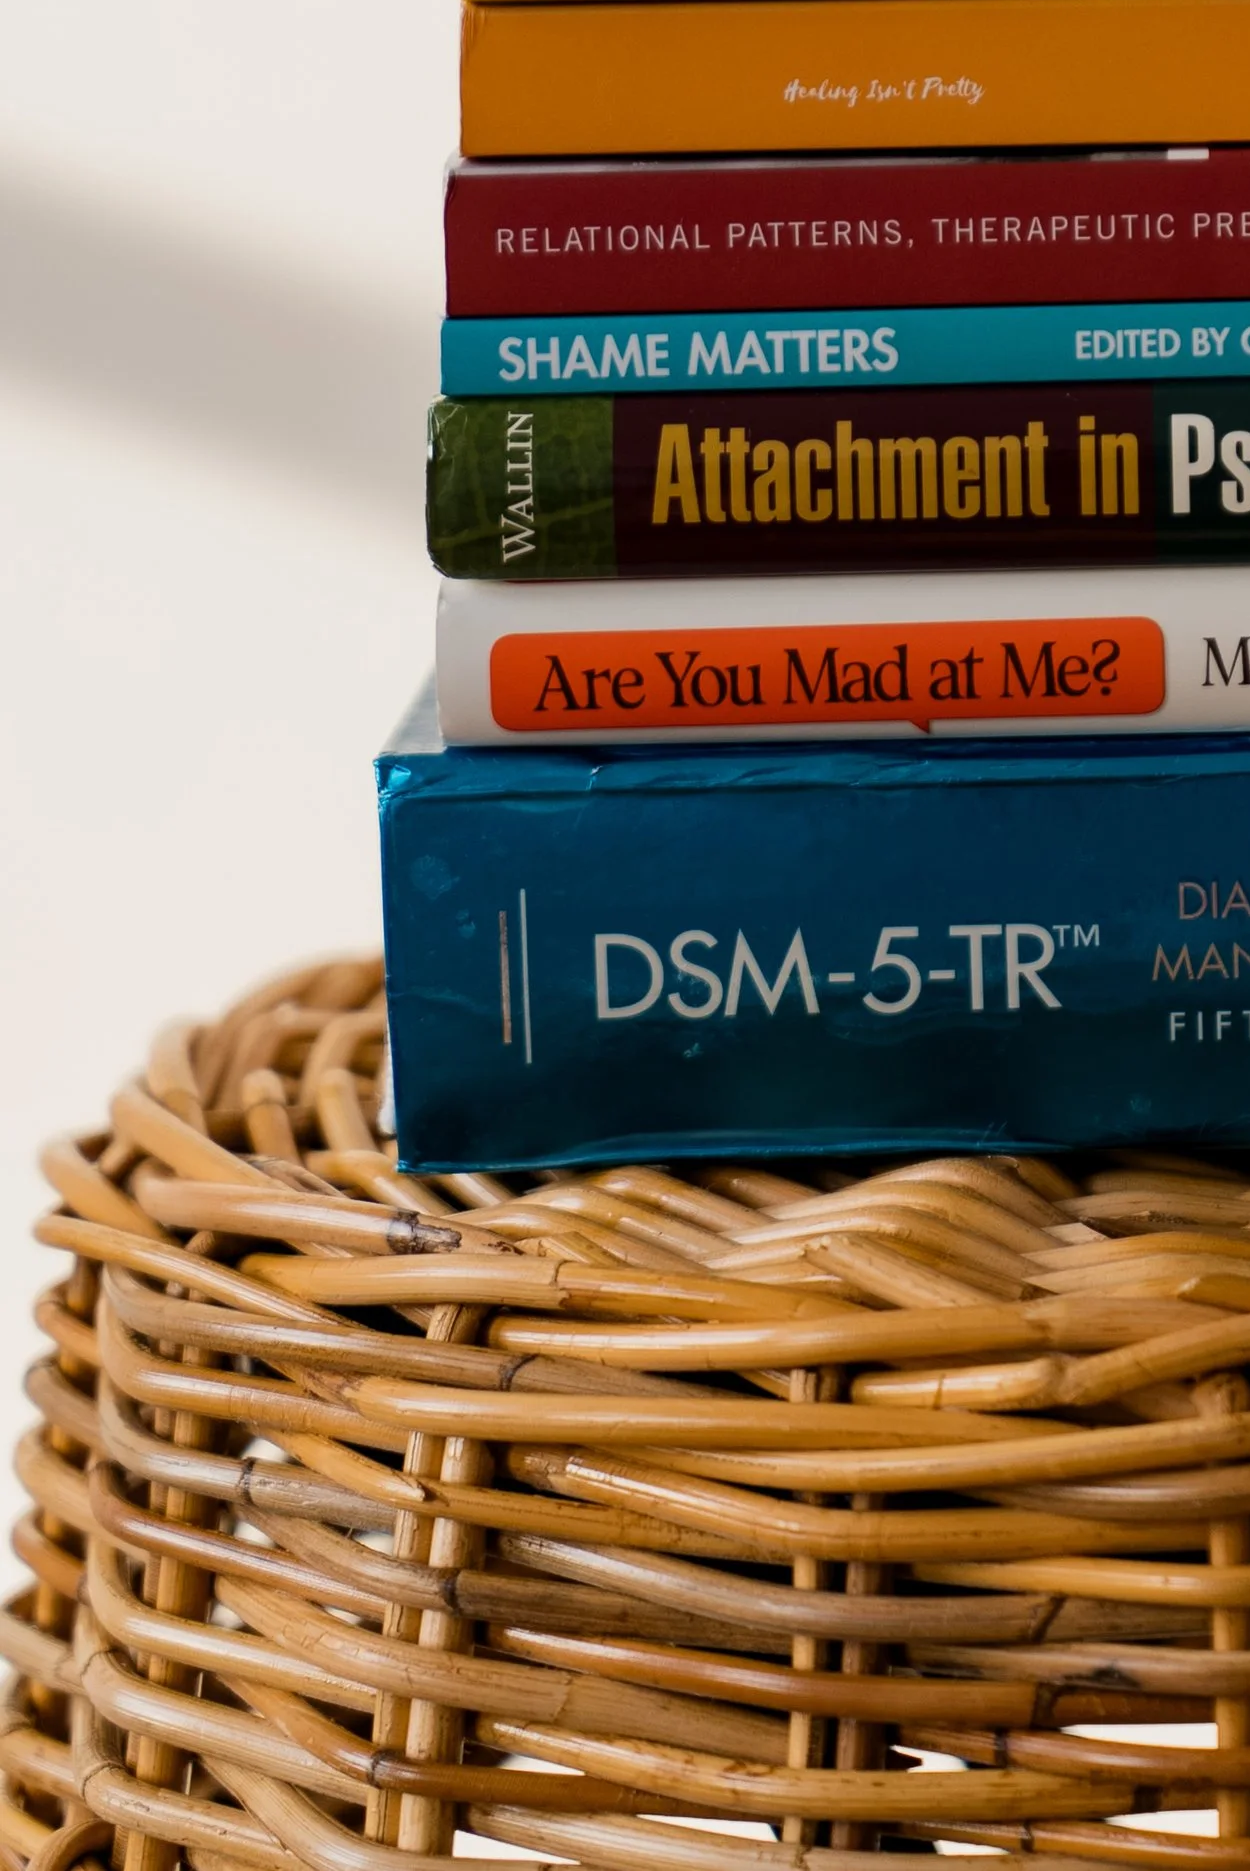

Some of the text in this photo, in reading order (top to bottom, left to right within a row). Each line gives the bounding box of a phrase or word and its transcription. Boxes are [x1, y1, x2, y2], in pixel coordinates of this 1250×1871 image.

[784, 79, 861, 108] Healing
[921, 77, 985, 104] Pretty
[495, 224, 711, 254] RELATIONAL
[727, 220, 914, 249] PATTERNS,
[931, 213, 1176, 243] THERAPEUTIC
[499, 327, 898, 380] SHAME MATTERS
[1075, 328, 1180, 361] EDITED
[1191, 327, 1232, 357] BY
[503, 410, 536, 563] WALLIN
[652, 416, 1048, 524] Attachment
[1080, 416, 1139, 516] in
[534, 639, 1120, 714] Are You Mad at Me?
